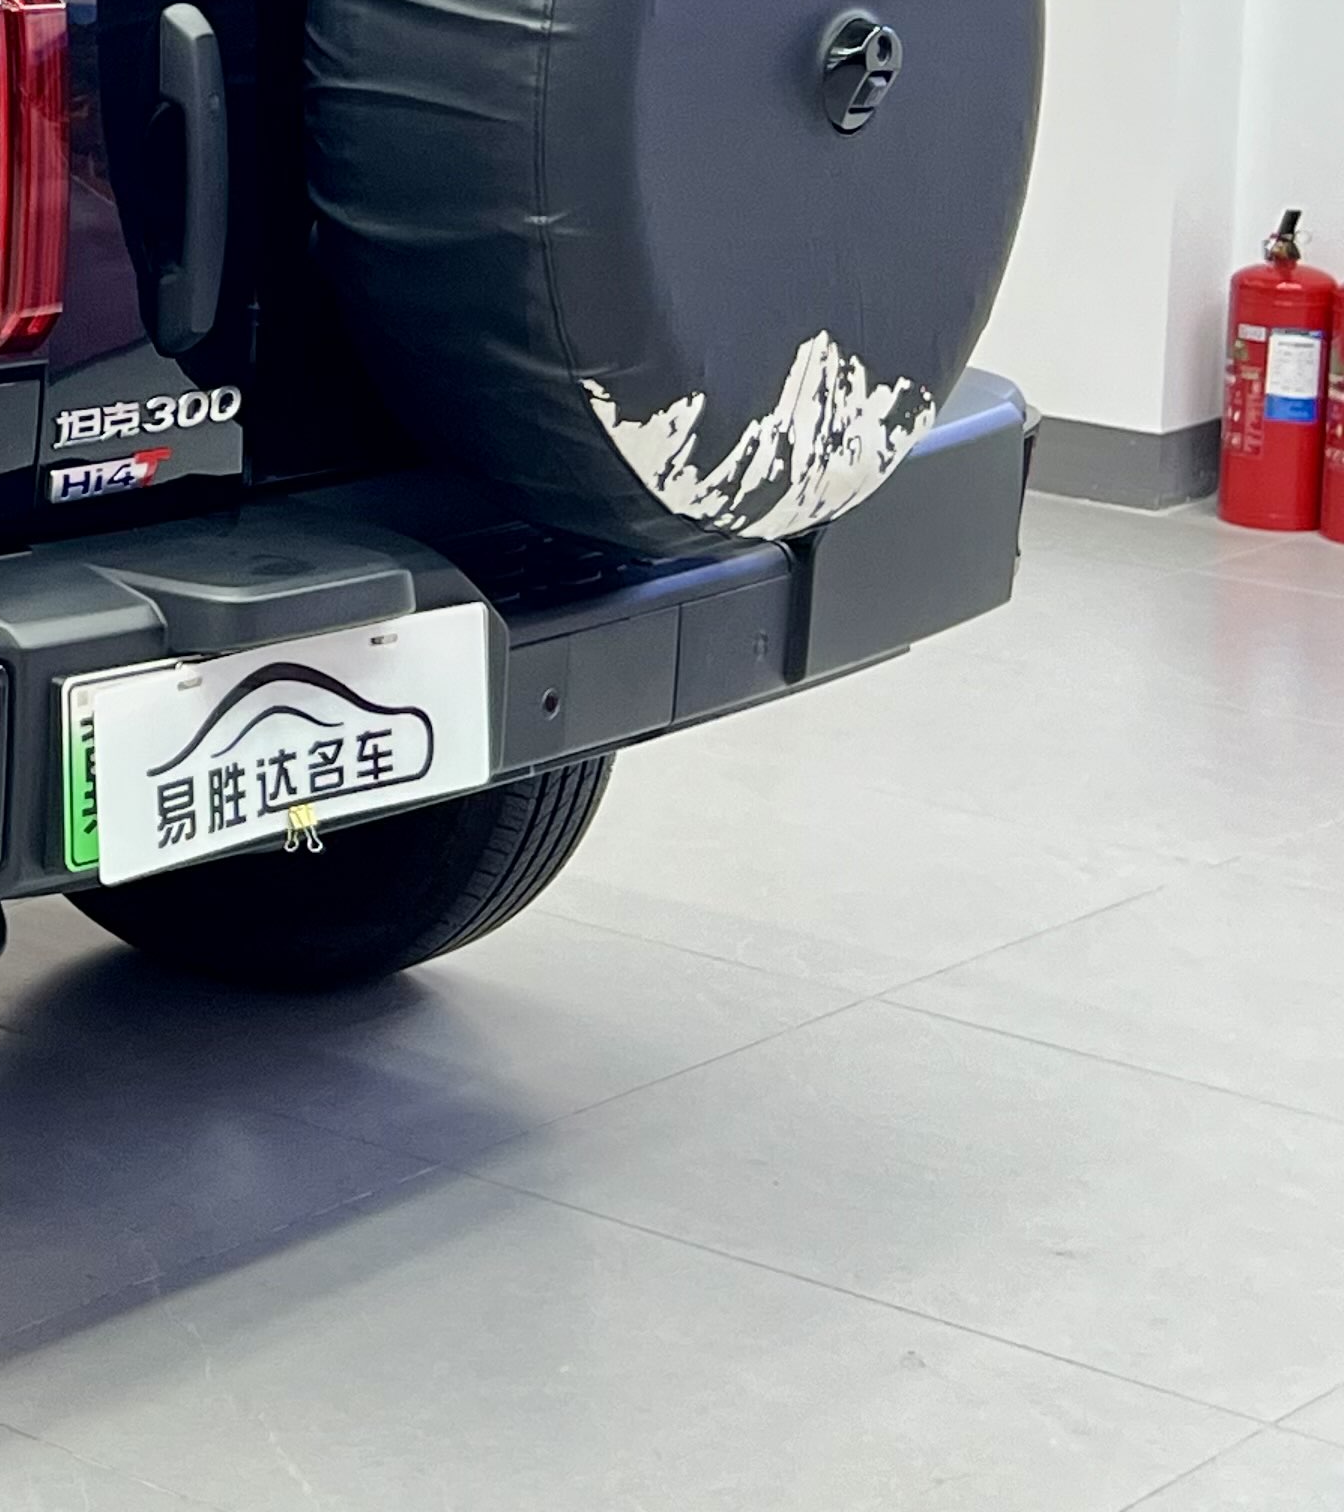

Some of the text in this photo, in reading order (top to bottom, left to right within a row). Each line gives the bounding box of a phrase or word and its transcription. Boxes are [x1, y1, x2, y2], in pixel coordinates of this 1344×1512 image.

[52, 385, 242, 450] 坦克300
[156, 727, 394, 850] 易胜达名车
